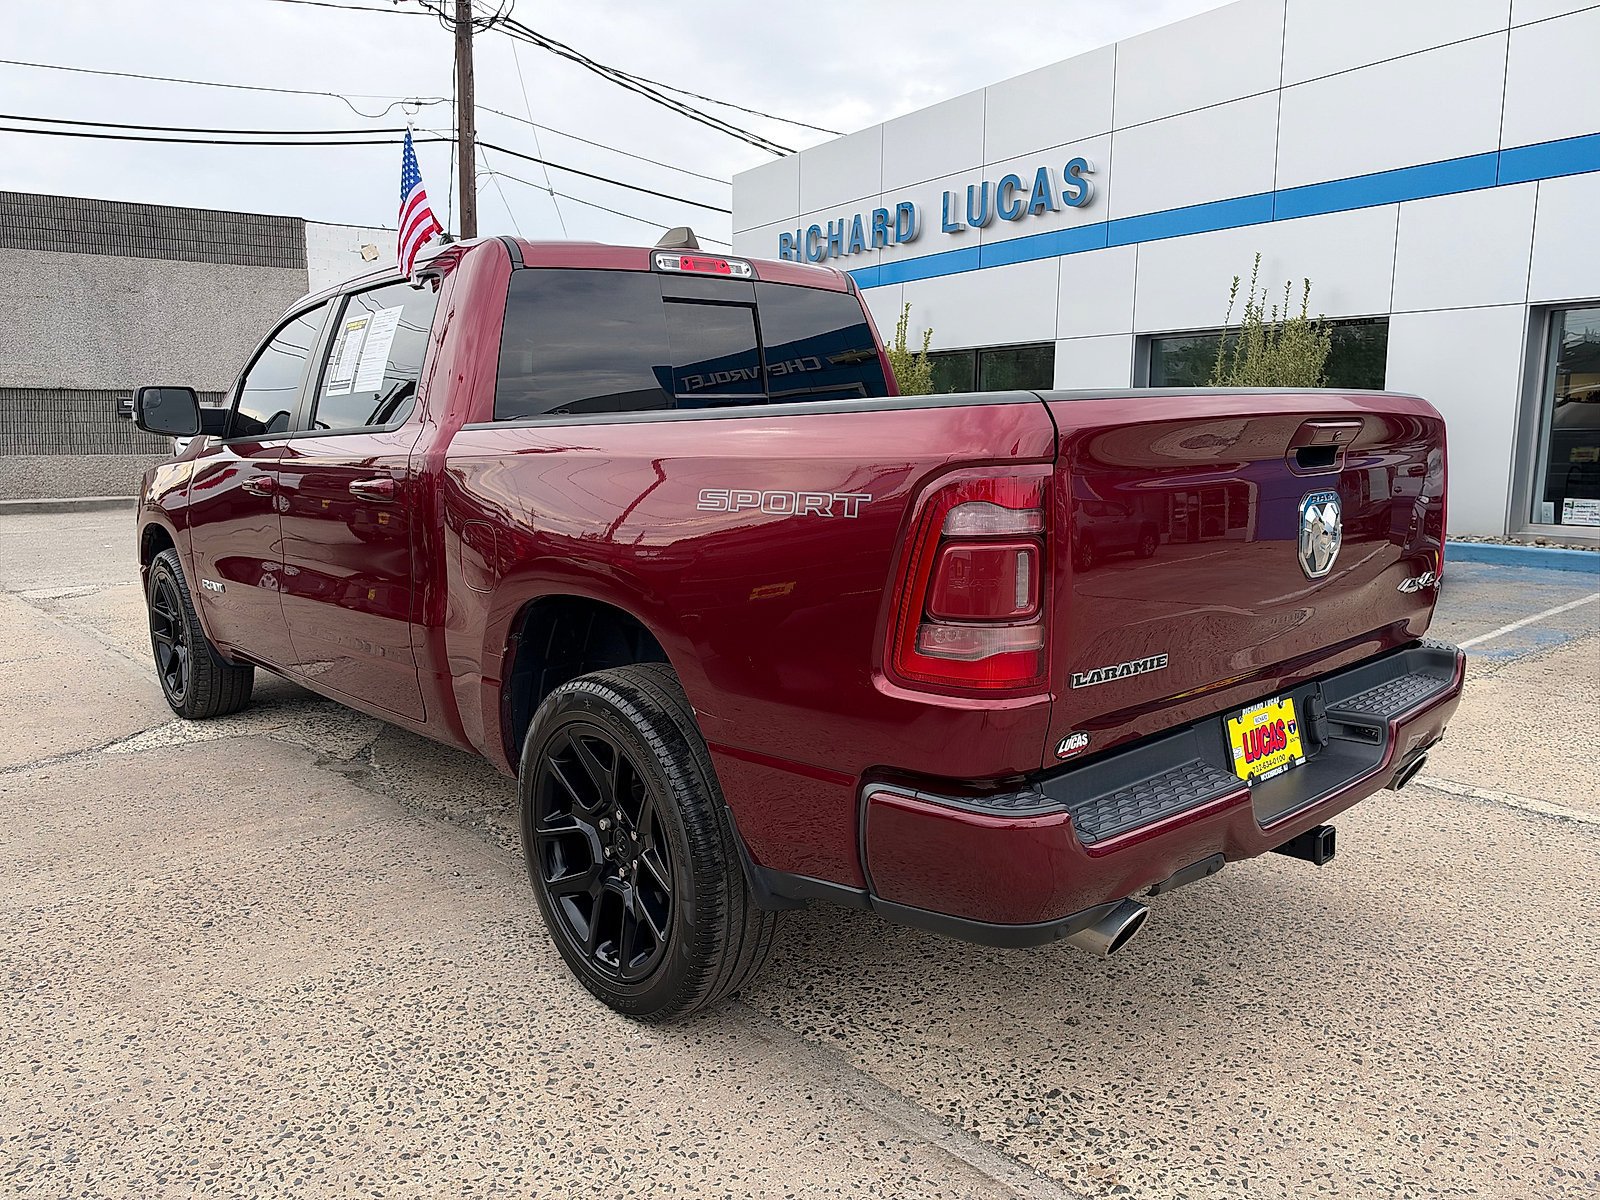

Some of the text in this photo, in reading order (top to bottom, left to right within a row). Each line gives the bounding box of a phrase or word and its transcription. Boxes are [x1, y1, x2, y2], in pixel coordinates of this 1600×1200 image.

[779, 157, 1095, 263] RICHARD LUCAS
[697, 488, 872, 518] SPORT
[1069, 653, 1169, 689] LARAMIE
[1057, 733, 1089, 754] LUCAS
[1242, 719, 1287, 763] LUCAS
